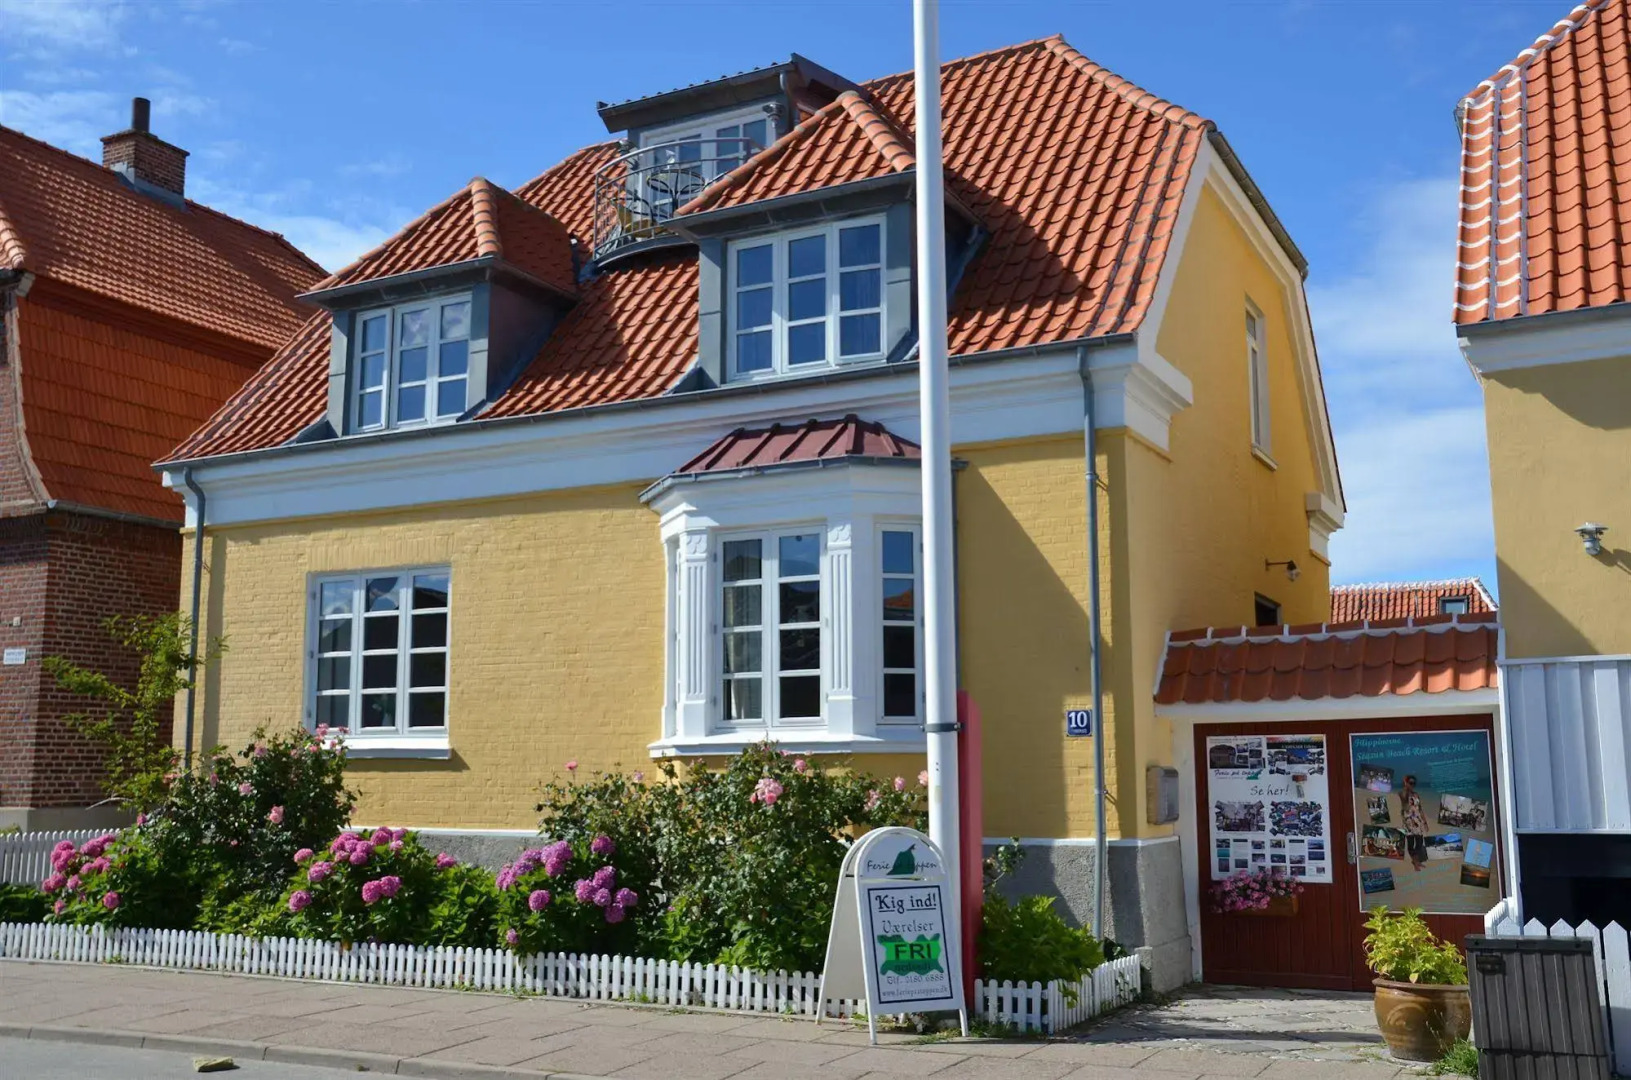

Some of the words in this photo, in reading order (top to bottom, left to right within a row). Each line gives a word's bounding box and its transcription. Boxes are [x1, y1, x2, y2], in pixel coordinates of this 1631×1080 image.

[1069, 711, 1088, 728] 10
[1452, 741, 1479, 753] Hotel
[1250, 785, 1264, 796] Se
[1266, 784, 1290, 796] her!
[867, 860, 890, 873] Ferie
[875, 894, 905, 914] Kig
[910, 892, 937, 909] ind!
[882, 920, 934, 934] Værelser
[894, 943, 932, 961] FRI
